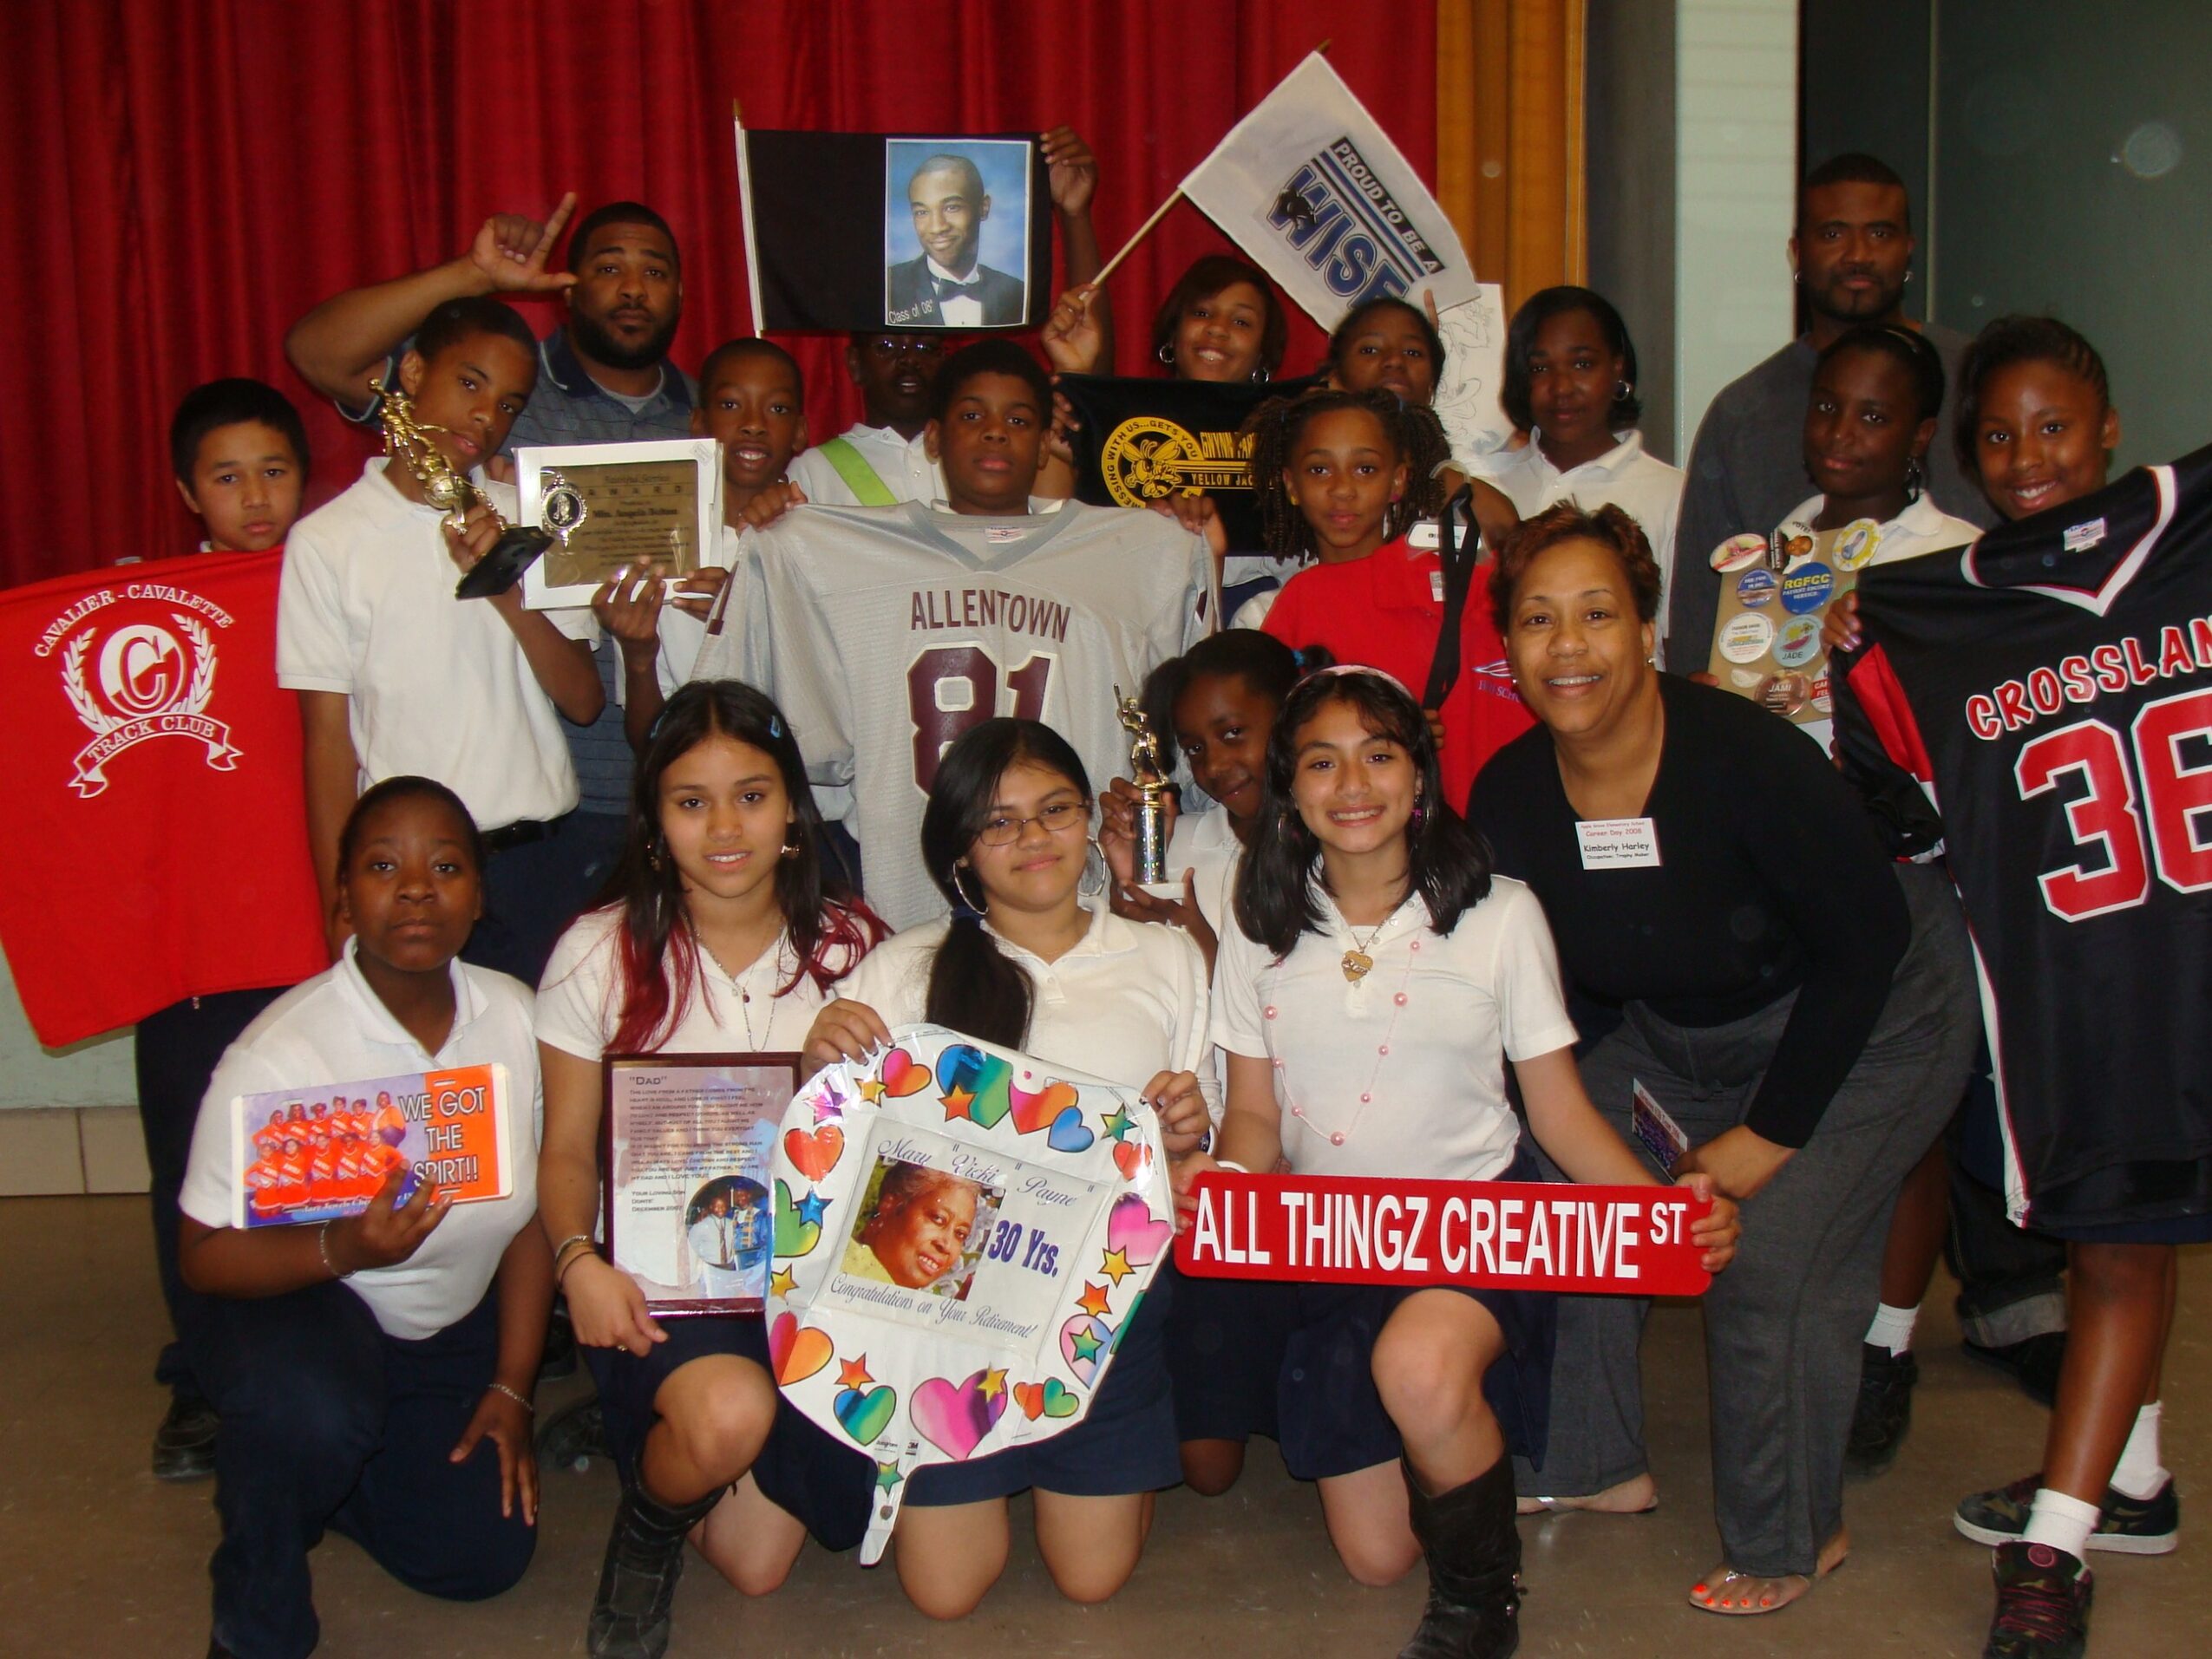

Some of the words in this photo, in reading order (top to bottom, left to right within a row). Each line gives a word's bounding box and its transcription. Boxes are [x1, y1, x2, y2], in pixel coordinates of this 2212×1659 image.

[1334, 142, 1384, 200] PROUD
[1380, 199, 1403, 225] TO
[1401, 230, 1425, 253] BE
[1423, 260, 1440, 275] A
[889, 309, 910, 323] Class
[912, 304, 920, 317] of
[1107, 432, 1126, 460] WITH
[1181, 434, 1198, 458] YOU
[1191, 474, 1230, 486] YELLOW
[1784, 573, 1830, 590] RGFCC
[912, 590, 1071, 643] ALLENTOWN
[1782, 651, 1803, 661] JADE
[88, 722, 154, 763] TRACK
[160, 716, 215, 737] CLUB
[2014, 688, 2212, 923] 36
[1583, 843, 1619, 852] Kimberly
[1621, 842, 1650, 851] Harley
[398, 1094, 432, 1121] WE
[437, 1087, 486, 1115] GOT
[425, 1124, 463, 1153] THE
[878, 1138, 932, 1166] Mary
[987, 1219, 1023, 1263] 30
[1023, 1228, 1059, 1278] Yrs.
[1192, 1187, 1270, 1264] ALL
[1280, 1192, 1430, 1272] THINGZ
[1440, 1196, 1640, 1279] CREATIVE
[1650, 1200, 1687, 1245] ST
[830, 1271, 913, 1310] Congratulations
[917, 1302, 933, 1314] on
[935, 1297, 967, 1325] Your
[969, 1306, 1037, 1339] Retirement!
